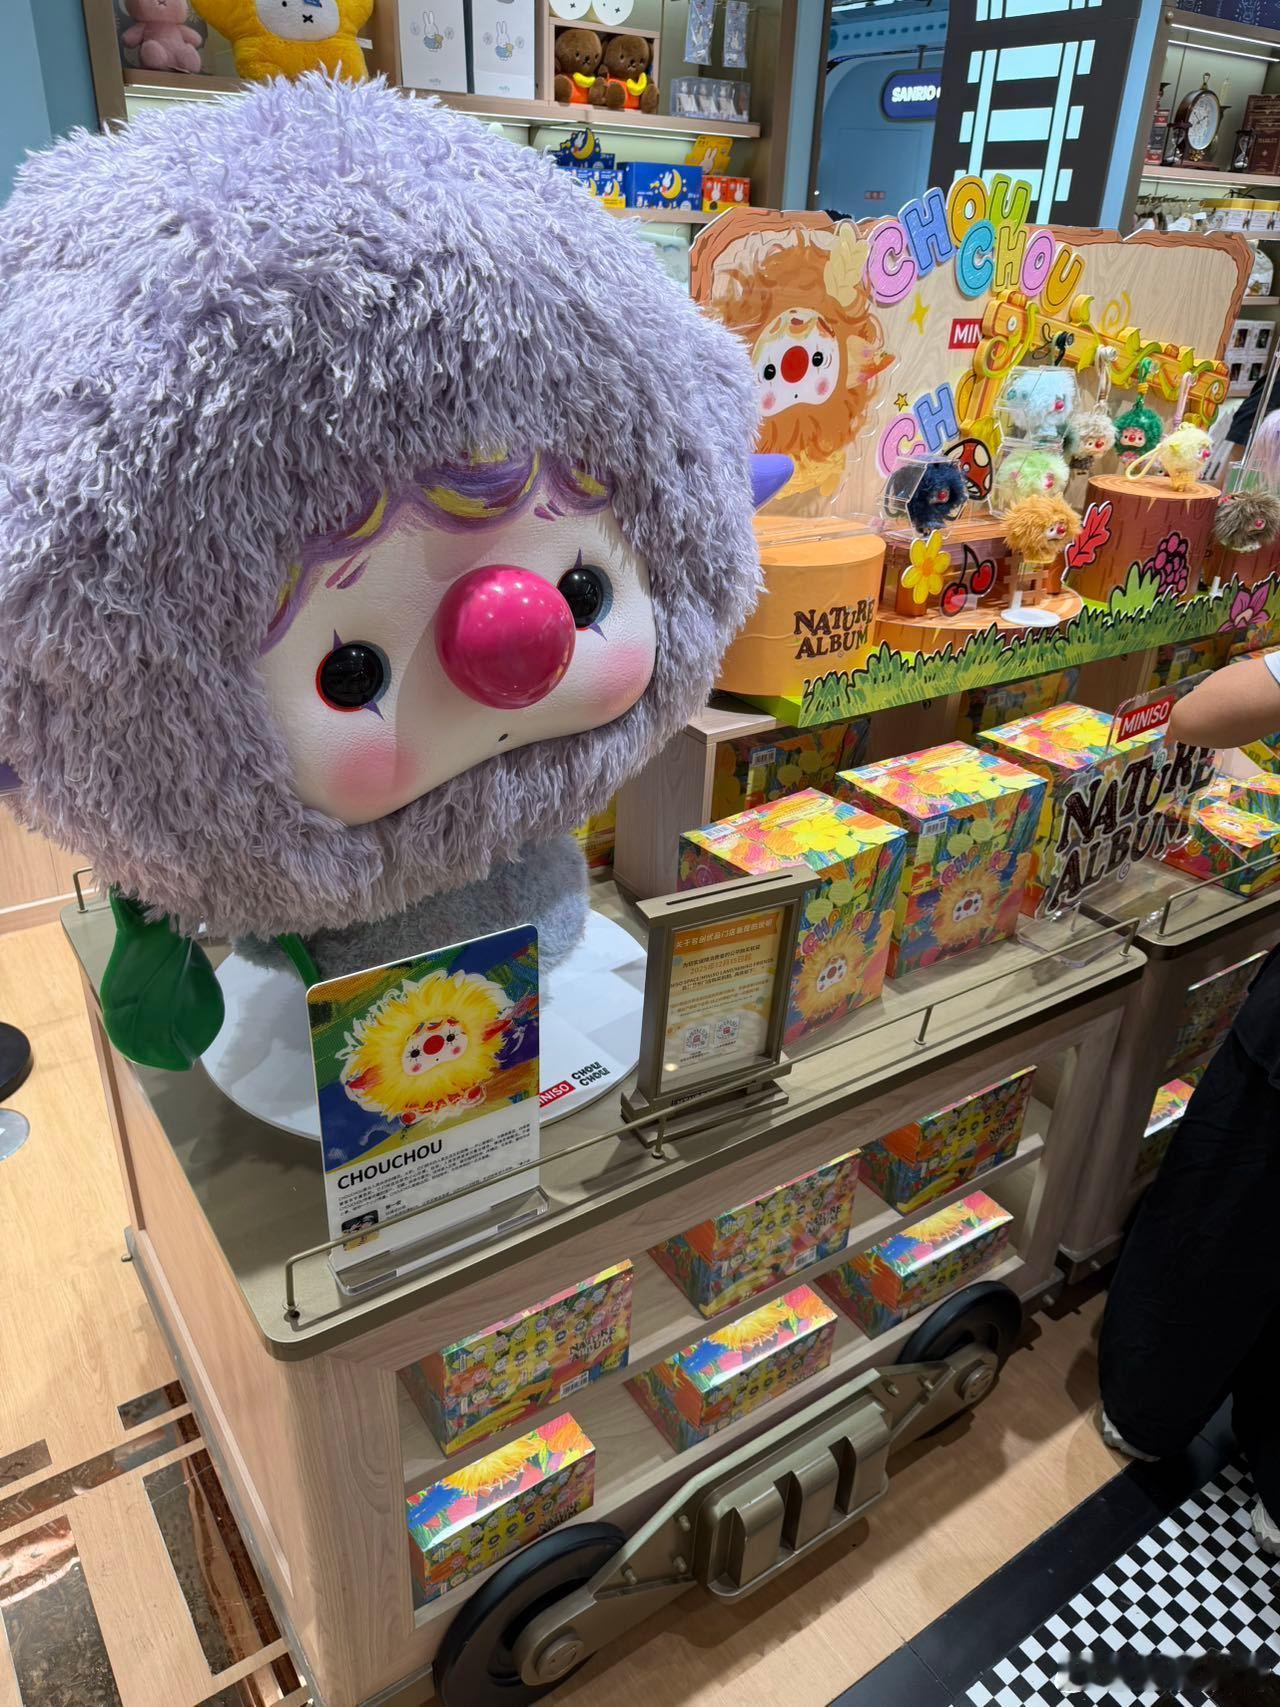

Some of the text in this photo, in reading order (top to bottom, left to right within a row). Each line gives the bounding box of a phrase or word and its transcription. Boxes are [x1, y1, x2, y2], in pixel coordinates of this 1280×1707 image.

[891, 85, 936, 103] SANRIO
[867, 173, 1032, 304] CHOU
[955, 220, 1085, 316] CHOU
[793, 599, 875, 636] NATURE
[794, 624, 869, 660] ALBUM
[1121, 700, 1170, 736] MINISO
[1056, 741, 1216, 854] NATURE
[1045, 811, 1191, 914] ALBUM
[571, 1061, 602, 1081] CHOU
[579, 1067, 611, 1087] CHOU
[337, 1138, 443, 1190] CHOUCHOU
